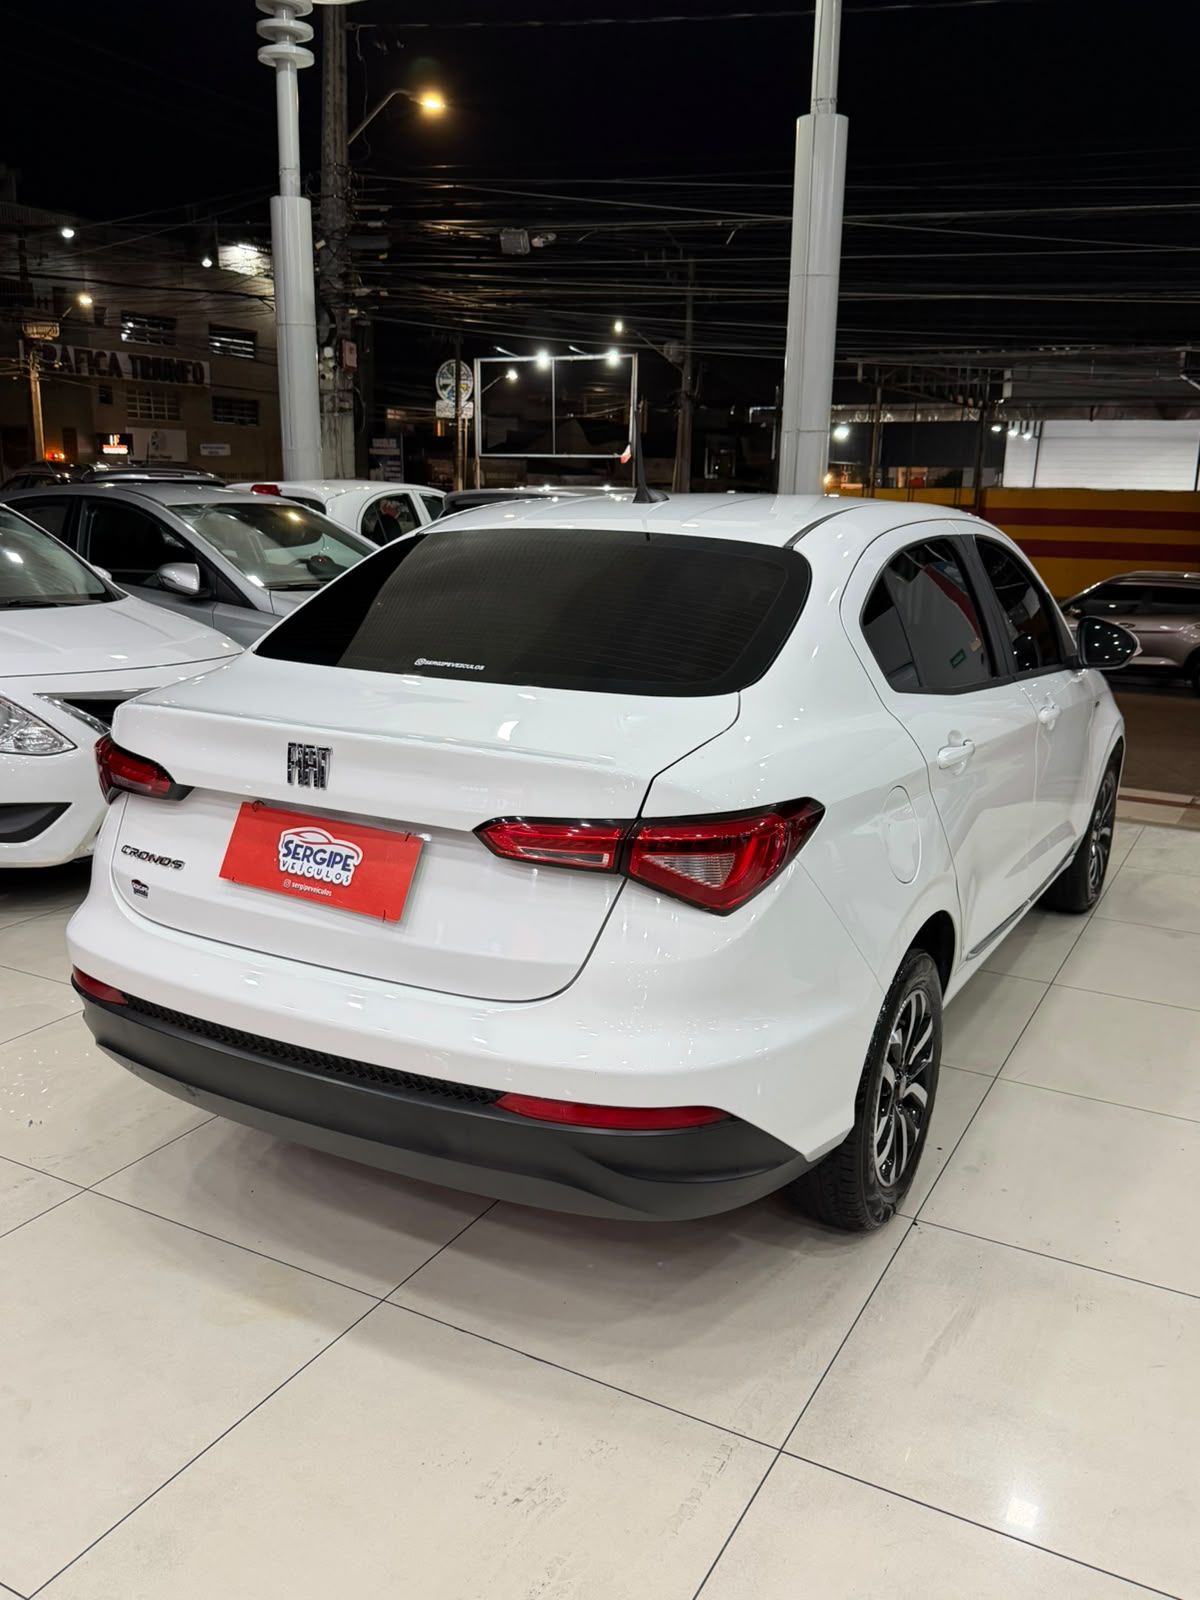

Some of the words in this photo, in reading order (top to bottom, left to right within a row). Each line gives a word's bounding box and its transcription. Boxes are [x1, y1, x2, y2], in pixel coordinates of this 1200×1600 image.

[28, 341, 122, 379] RAFICA
[287, 742, 333, 791] FIAT
[121, 844, 186, 871] CRONOS
[282, 839, 355, 872] SERGIPE
[291, 881, 333, 897] sergipeveiculos
